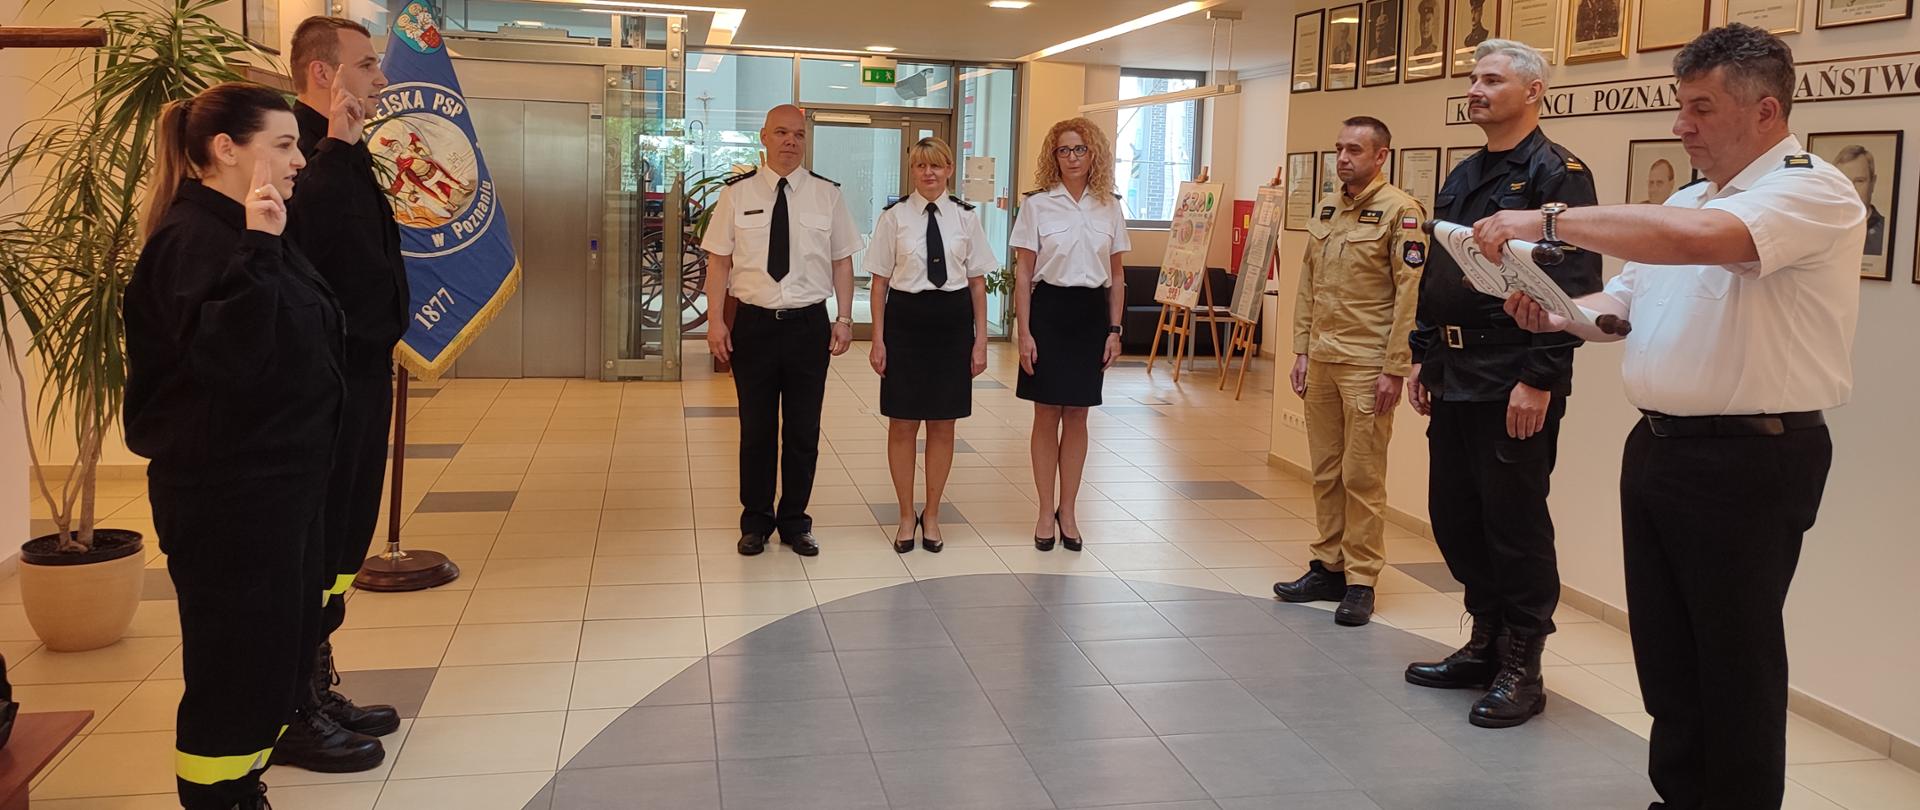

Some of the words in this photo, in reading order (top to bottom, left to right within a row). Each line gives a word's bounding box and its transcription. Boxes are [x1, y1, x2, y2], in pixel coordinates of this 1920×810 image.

[1794, 62, 1920, 98] AŃSTW
[433, 93, 464, 118] PSP
[451, 180, 492, 240] Poznaniu
[414, 287, 456, 331] 1877
